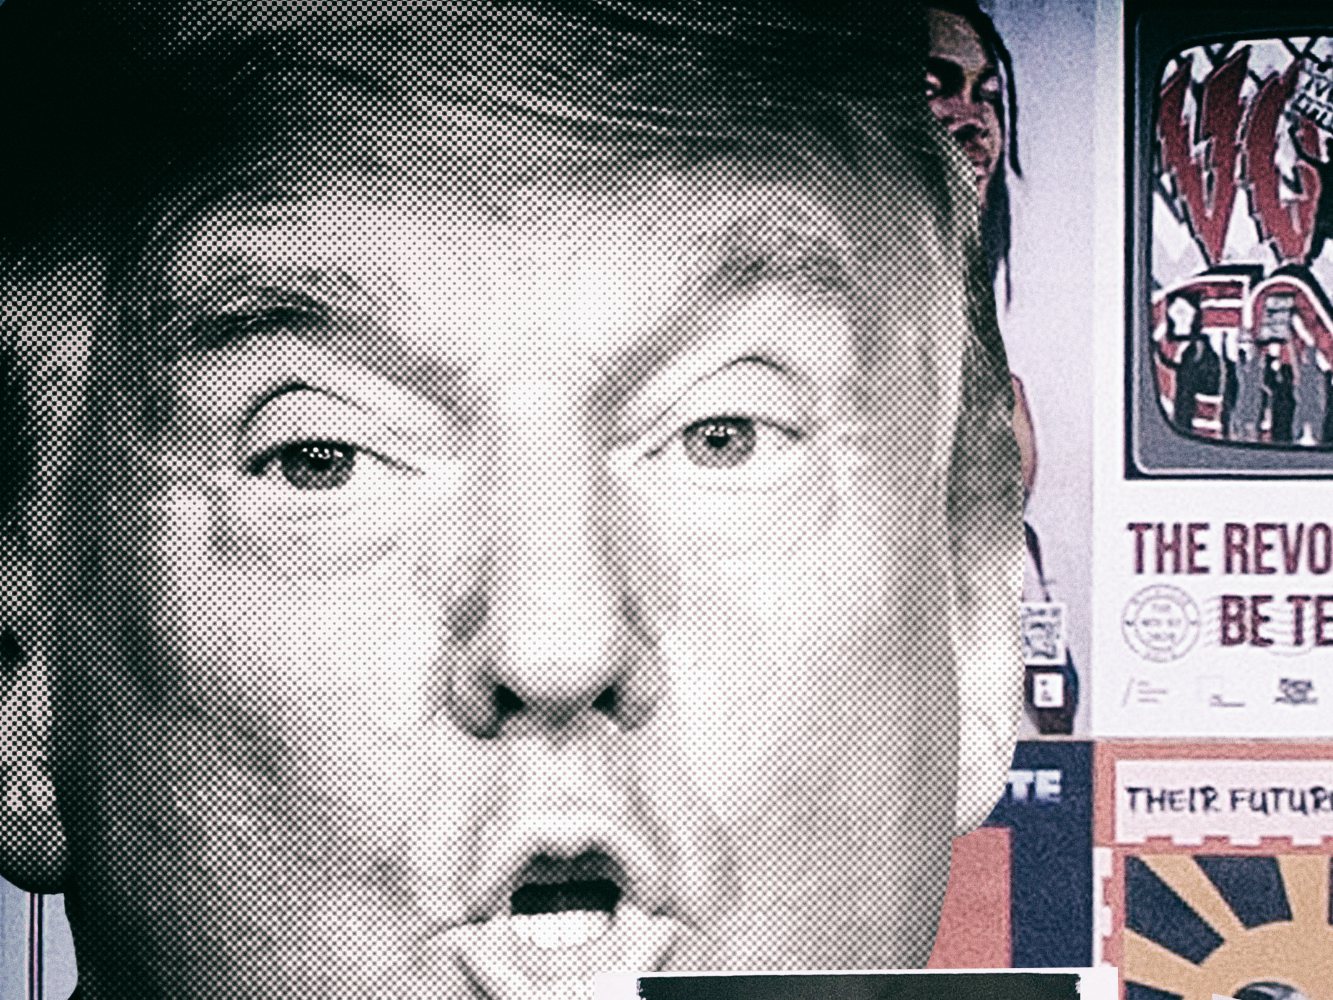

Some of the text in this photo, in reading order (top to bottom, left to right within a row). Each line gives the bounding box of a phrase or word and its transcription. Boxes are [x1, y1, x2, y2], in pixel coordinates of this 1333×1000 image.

[1127, 522, 1210, 576] THE
[1220, 595, 1274, 648] BE
[1007, 769, 1062, 802] TE
[1125, 785, 1222, 815] THEIR
